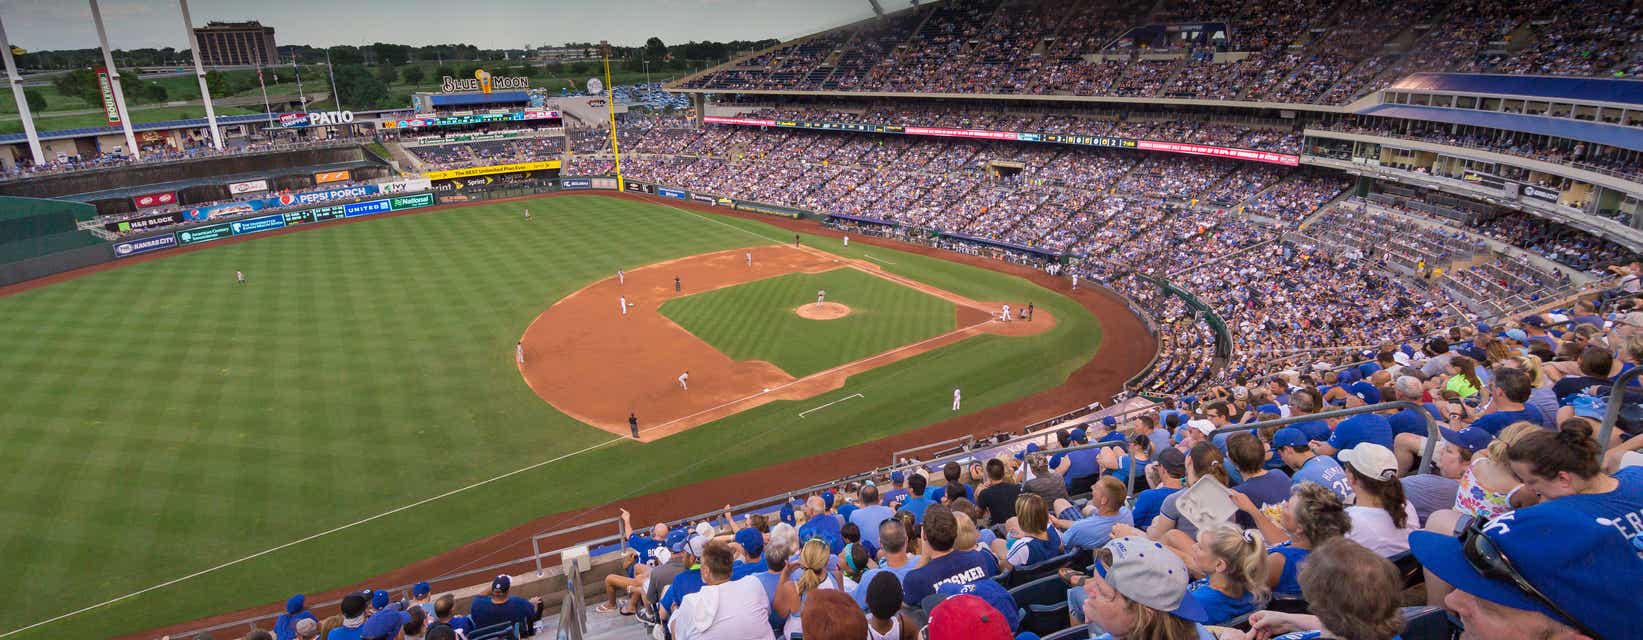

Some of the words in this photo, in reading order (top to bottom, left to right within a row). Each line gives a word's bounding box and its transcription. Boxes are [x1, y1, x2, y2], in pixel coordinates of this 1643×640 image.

[442, 75, 478, 94] BLUE
[492, 76, 529, 89] MOON
[309, 111, 354, 125] PATIO
[300, 192, 330, 203] PEPSI
[330, 187, 366, 199] PORCH
[348, 204, 379, 213] UNITED
[148, 215, 174, 225] BLOCK
[160, 237, 174, 245] CITY
